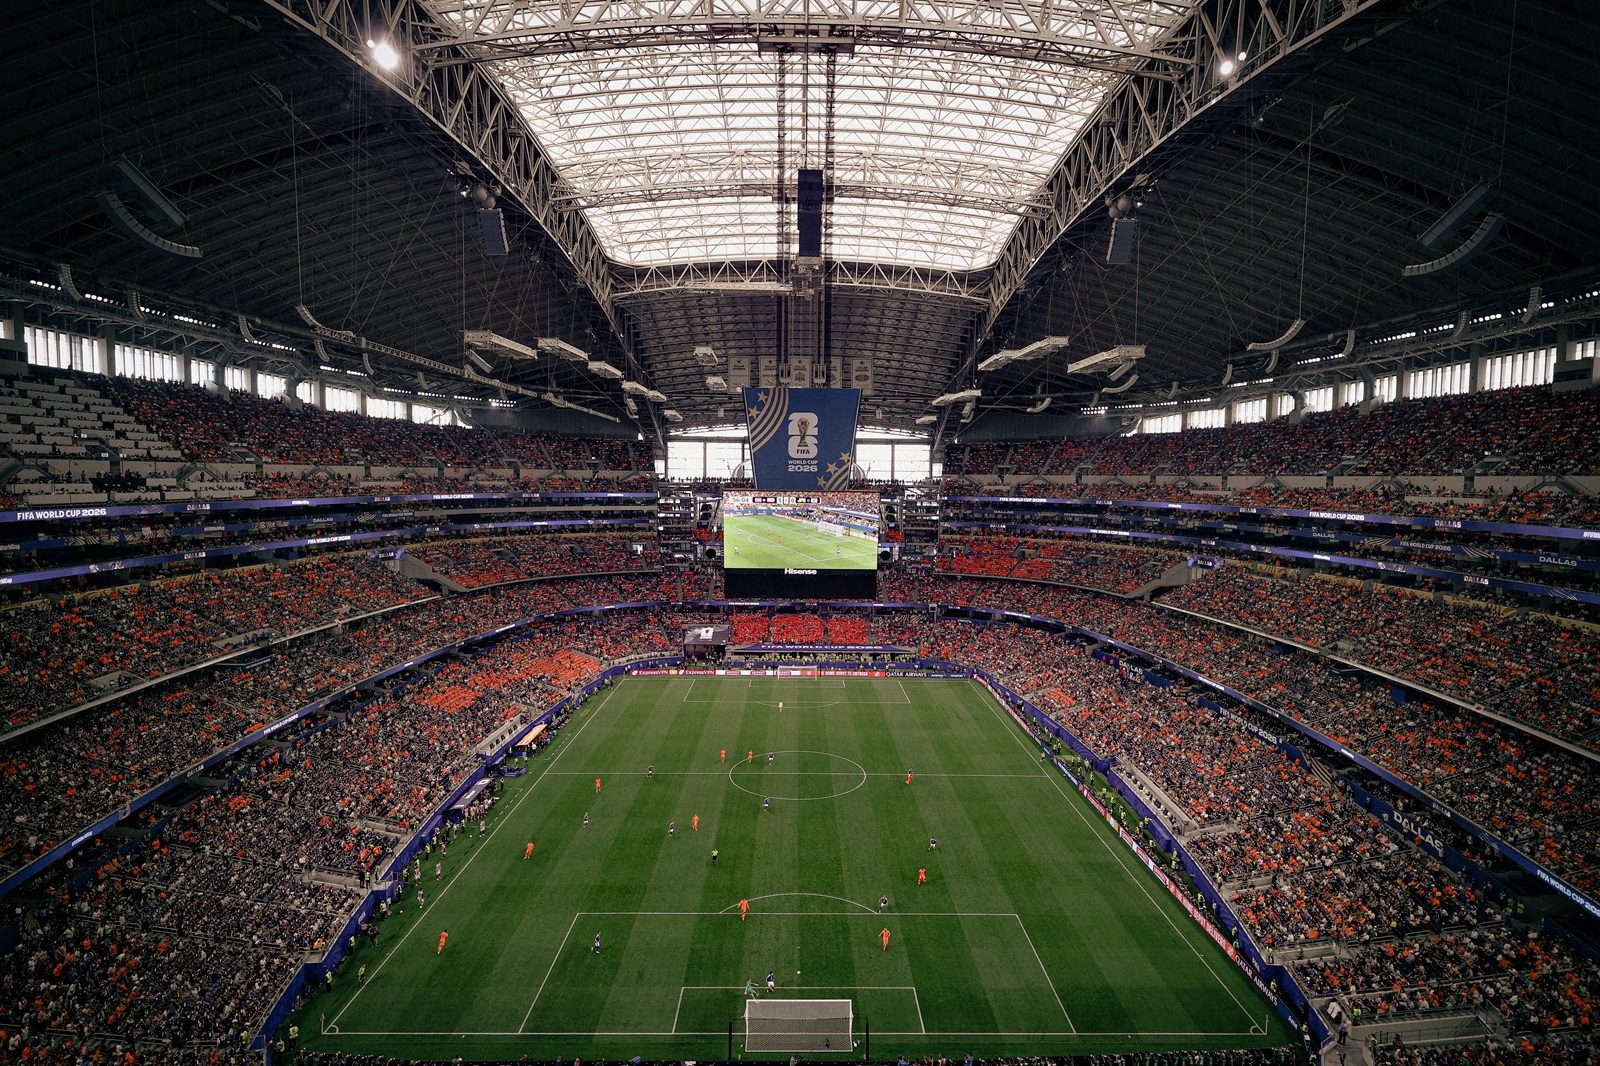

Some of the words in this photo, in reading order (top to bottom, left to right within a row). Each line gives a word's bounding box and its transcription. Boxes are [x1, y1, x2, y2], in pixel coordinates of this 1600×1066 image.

[17, 511, 34, 520] FIFA
[36, 510, 65, 519] WORLD
[65, 509, 81, 517] CUP
[82, 508, 107, 517] 2026
[1434, 520, 1462, 528] DALLAS
[1539, 556, 1578, 567] DALLAS
[1464, 575, 1489, 585] DALLAS
[1393, 810, 1444, 850] DALLAS
[1537, 869, 1550, 883] FIFA
[1550, 877, 1572, 897] WORLD
[1571, 893, 1585, 904] CUP
[1584, 901, 1600, 918] 202
[1236, 955, 1253, 979] QATAR
[1253, 975, 1278, 1006] AIRWAYS
